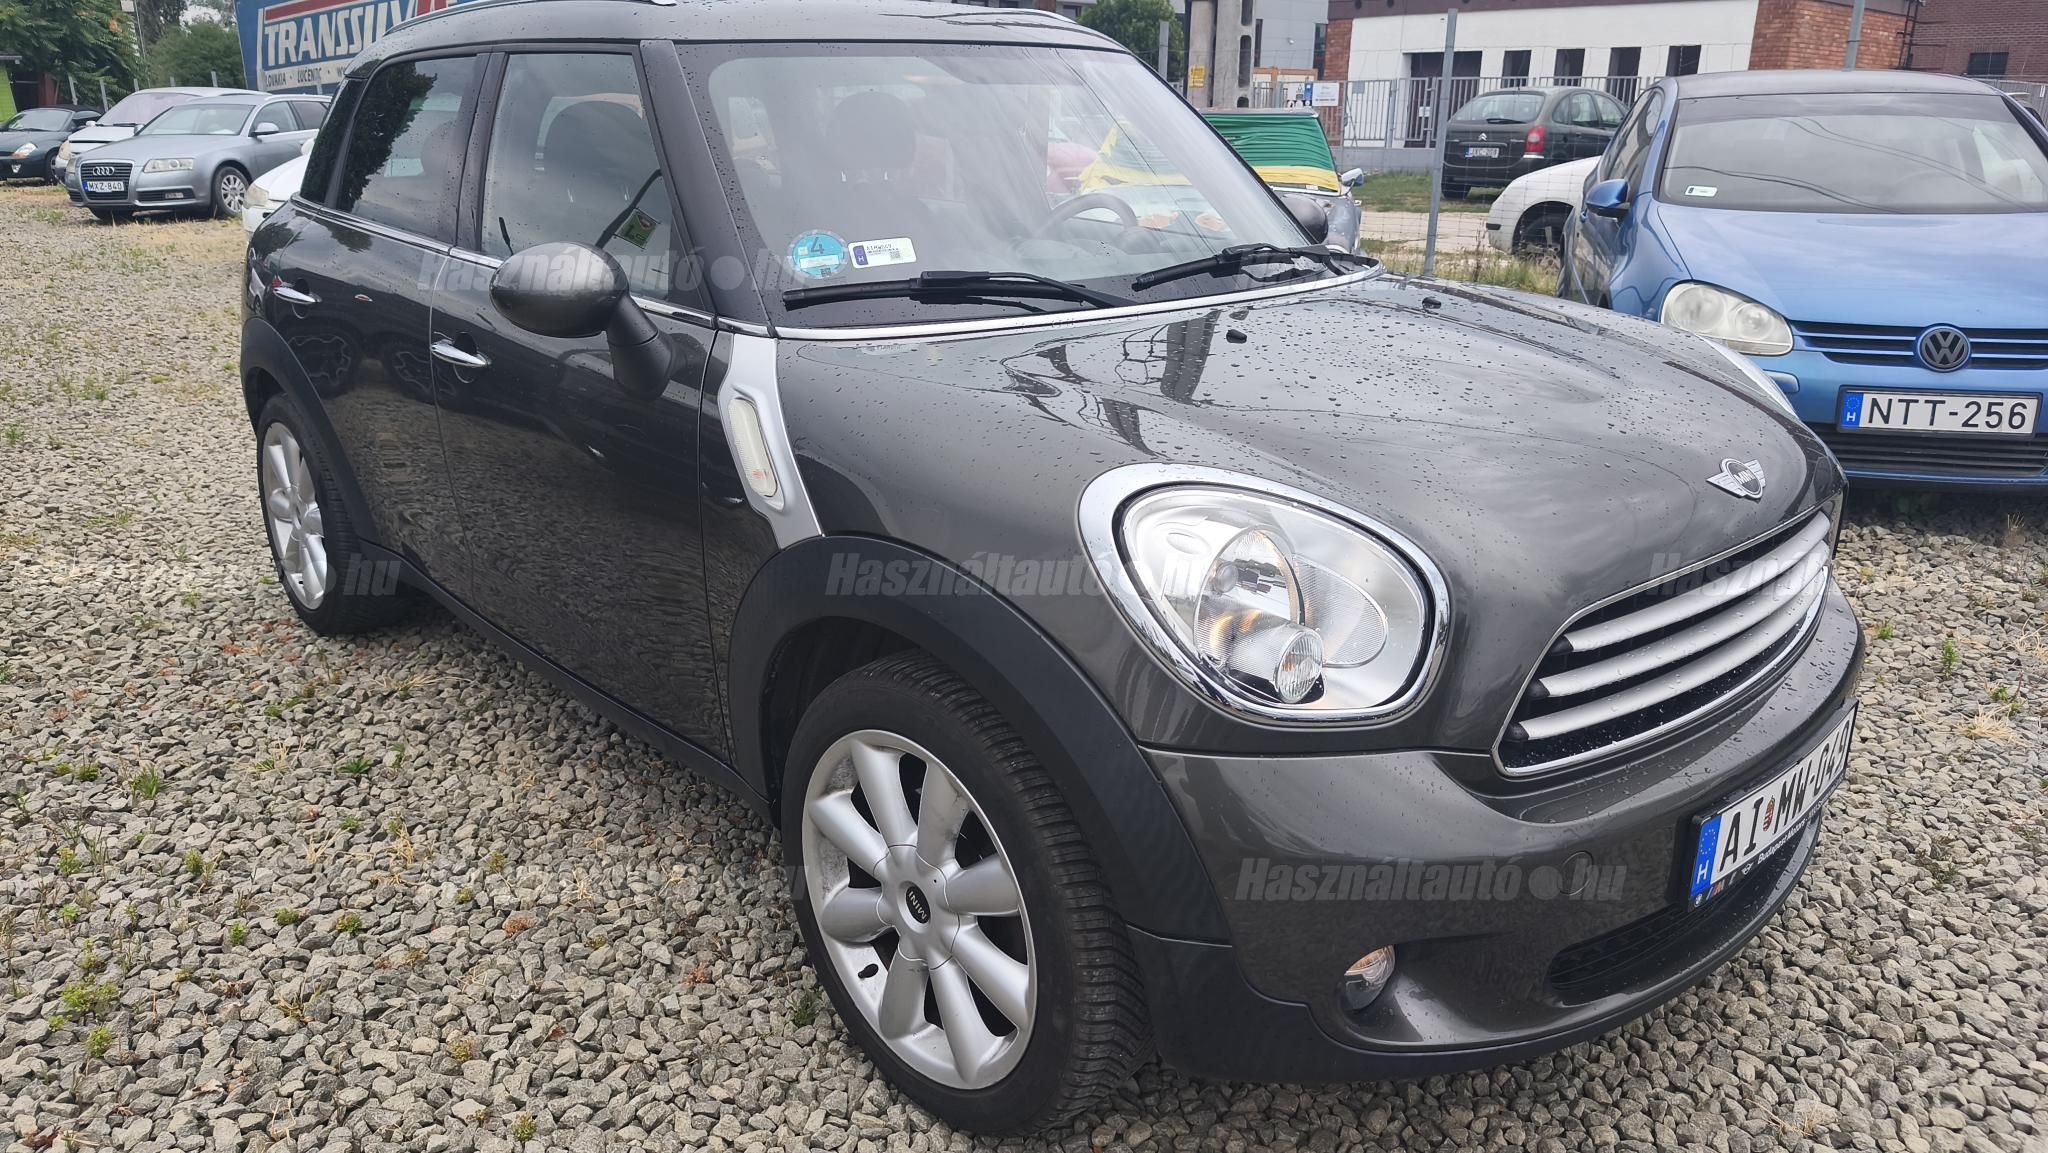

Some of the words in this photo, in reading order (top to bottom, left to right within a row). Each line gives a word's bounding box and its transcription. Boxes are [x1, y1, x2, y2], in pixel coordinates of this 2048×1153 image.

[811, 237, 825, 255] 4
[1845, 411, 1857, 423] H
[1867, 397, 2029, 430] NTT-256
[1718, 796, 1765, 873] AI
[1696, 859, 1710, 885] H
[908, 890, 928, 920] MINI
